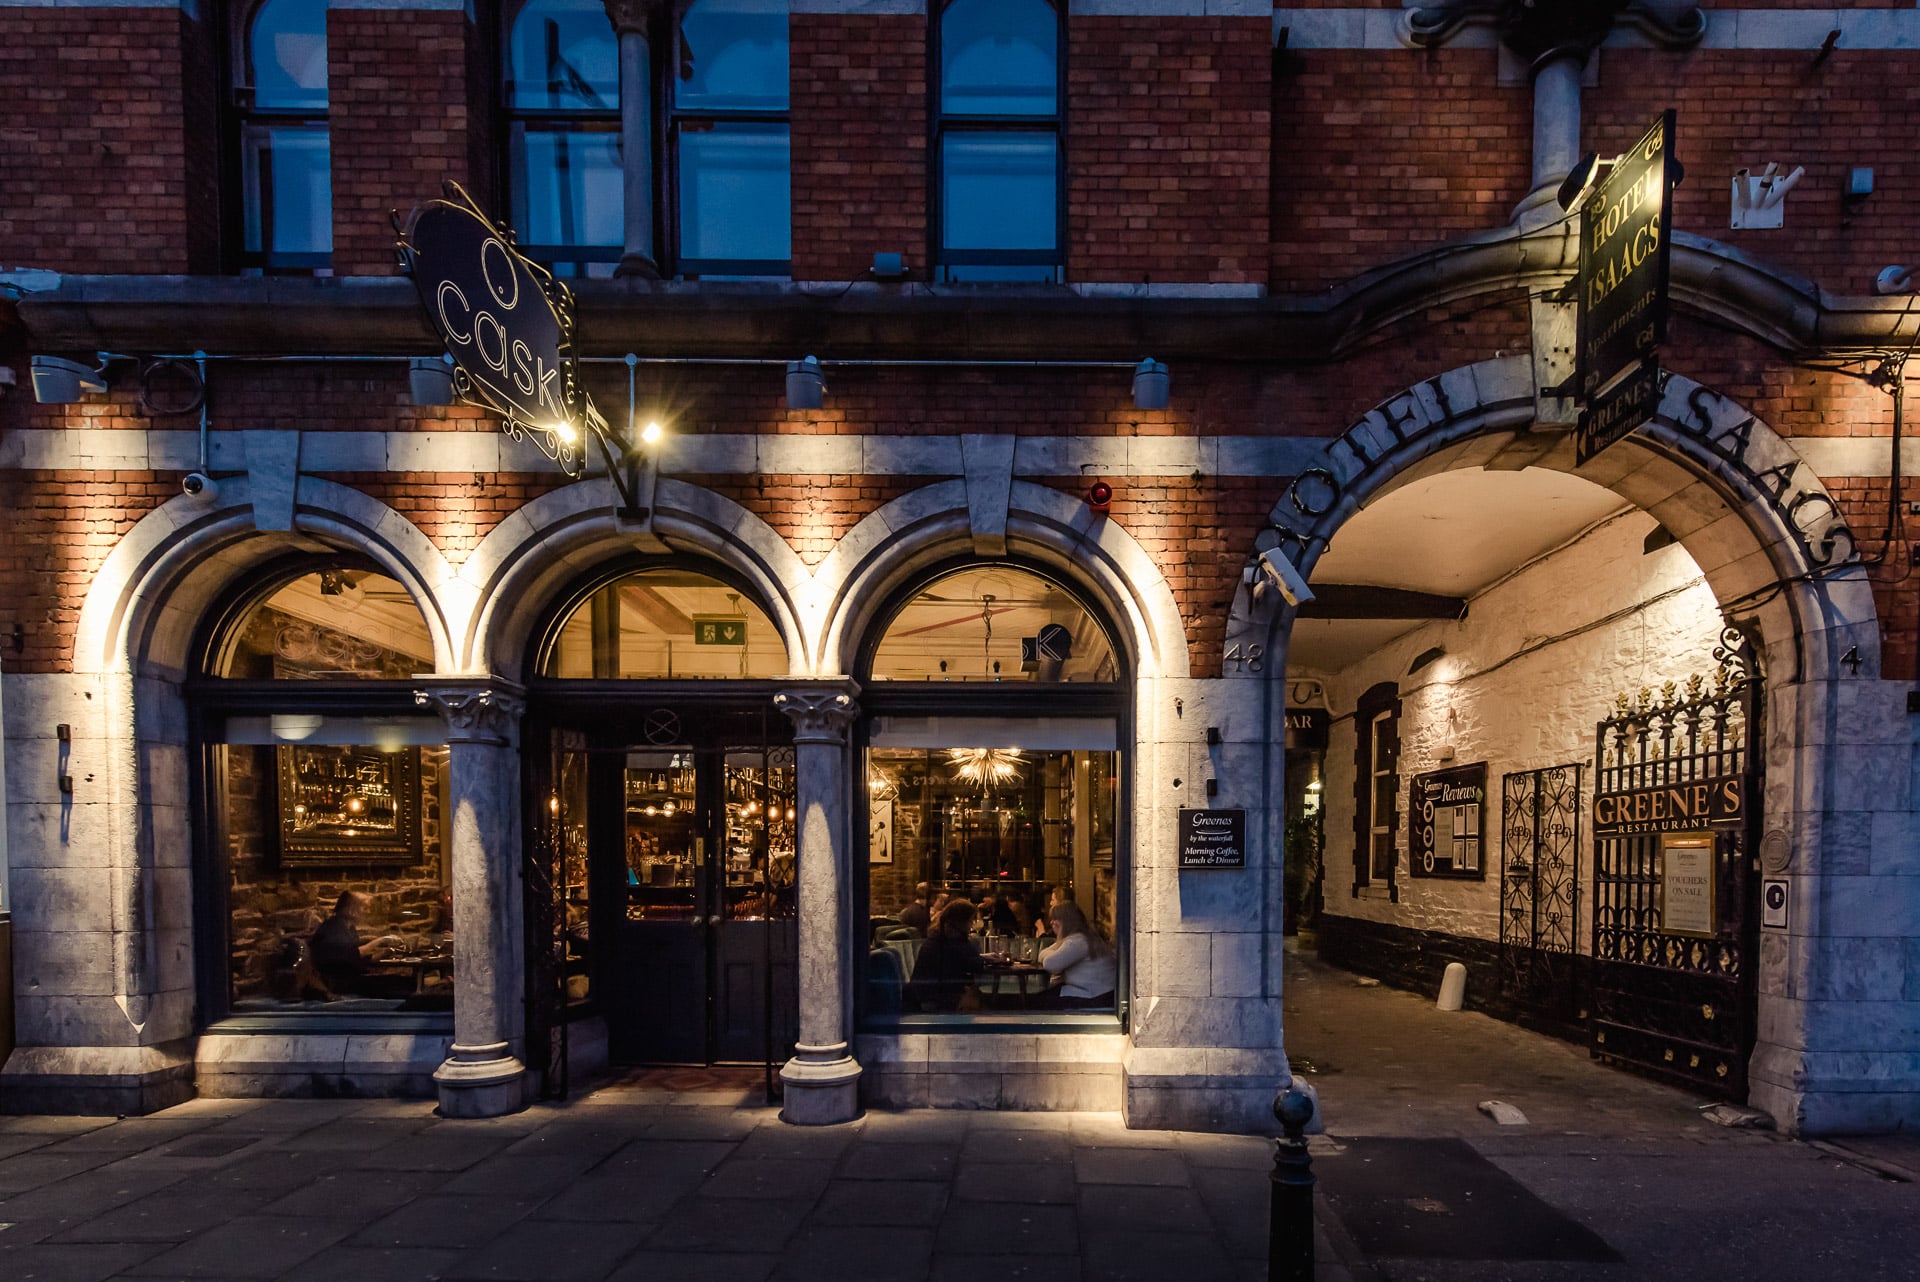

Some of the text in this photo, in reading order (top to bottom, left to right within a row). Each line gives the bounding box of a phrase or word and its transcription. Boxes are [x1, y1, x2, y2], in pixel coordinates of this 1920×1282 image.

[1592, 165, 1661, 255] HOTEL
[1586, 212, 1660, 313] ISAACS
[1224, 643, 1263, 673] 48
[1839, 645, 1864, 675] 4
[1442, 784, 1476, 802] Reviews
[1594, 780, 1741, 825] GREENE'S
[1192, 813, 1232, 827] Greenes
[1618, 818, 1711, 834] RESTAURANT
[1184, 847, 1215, 857] Morning
[1184, 856, 1206, 864] Lunch
[1668, 875, 1708, 886] VOUCHERS
[1672, 887, 1702, 897] ON SALE
